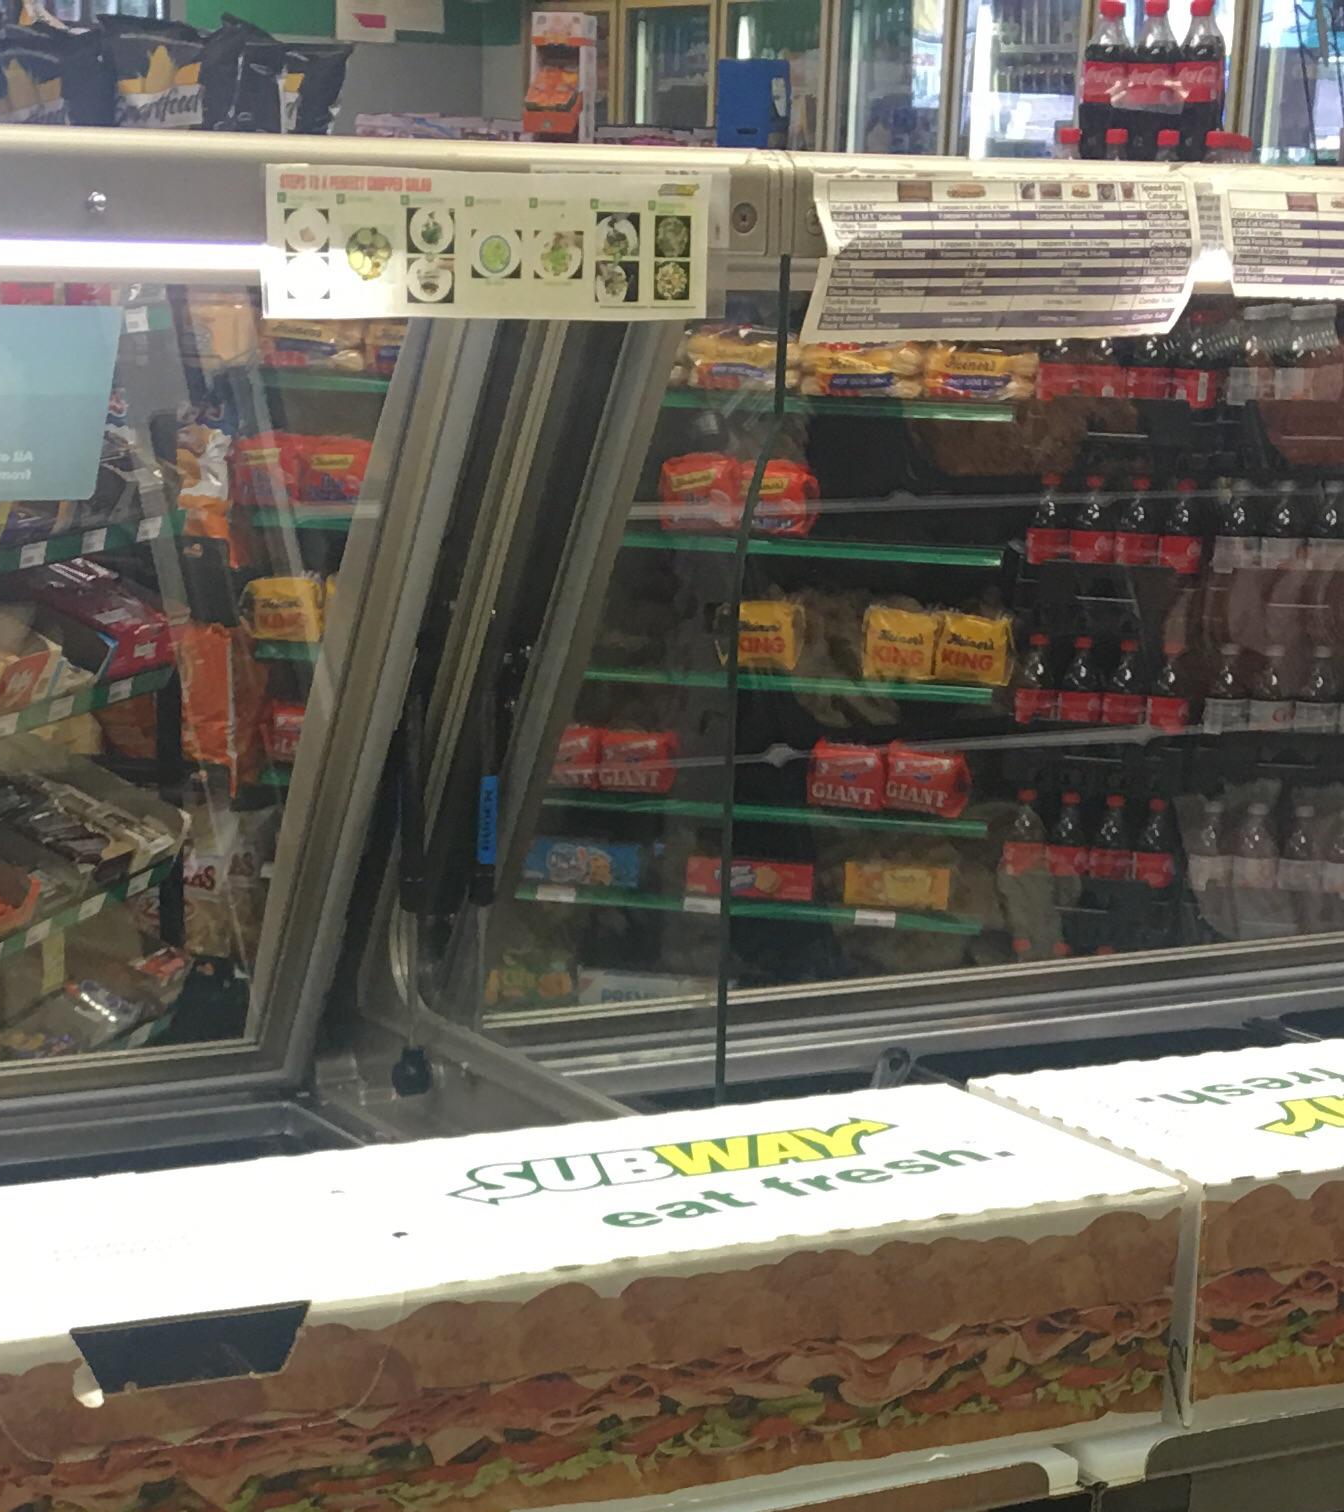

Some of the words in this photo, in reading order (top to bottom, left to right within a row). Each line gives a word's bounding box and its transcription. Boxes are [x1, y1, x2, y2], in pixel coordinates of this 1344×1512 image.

[872, 645, 925, 667] KING
[941, 647, 994, 671] KING
[597, 769, 663, 787] GIANT
[811, 781, 876, 806] GIANT
[886, 780, 949, 808] GIANT
[446, 1117, 899, 1206] SUBWAY
[602, 1189, 757, 1228] eat
[760, 1144, 1016, 1199] fresh.
